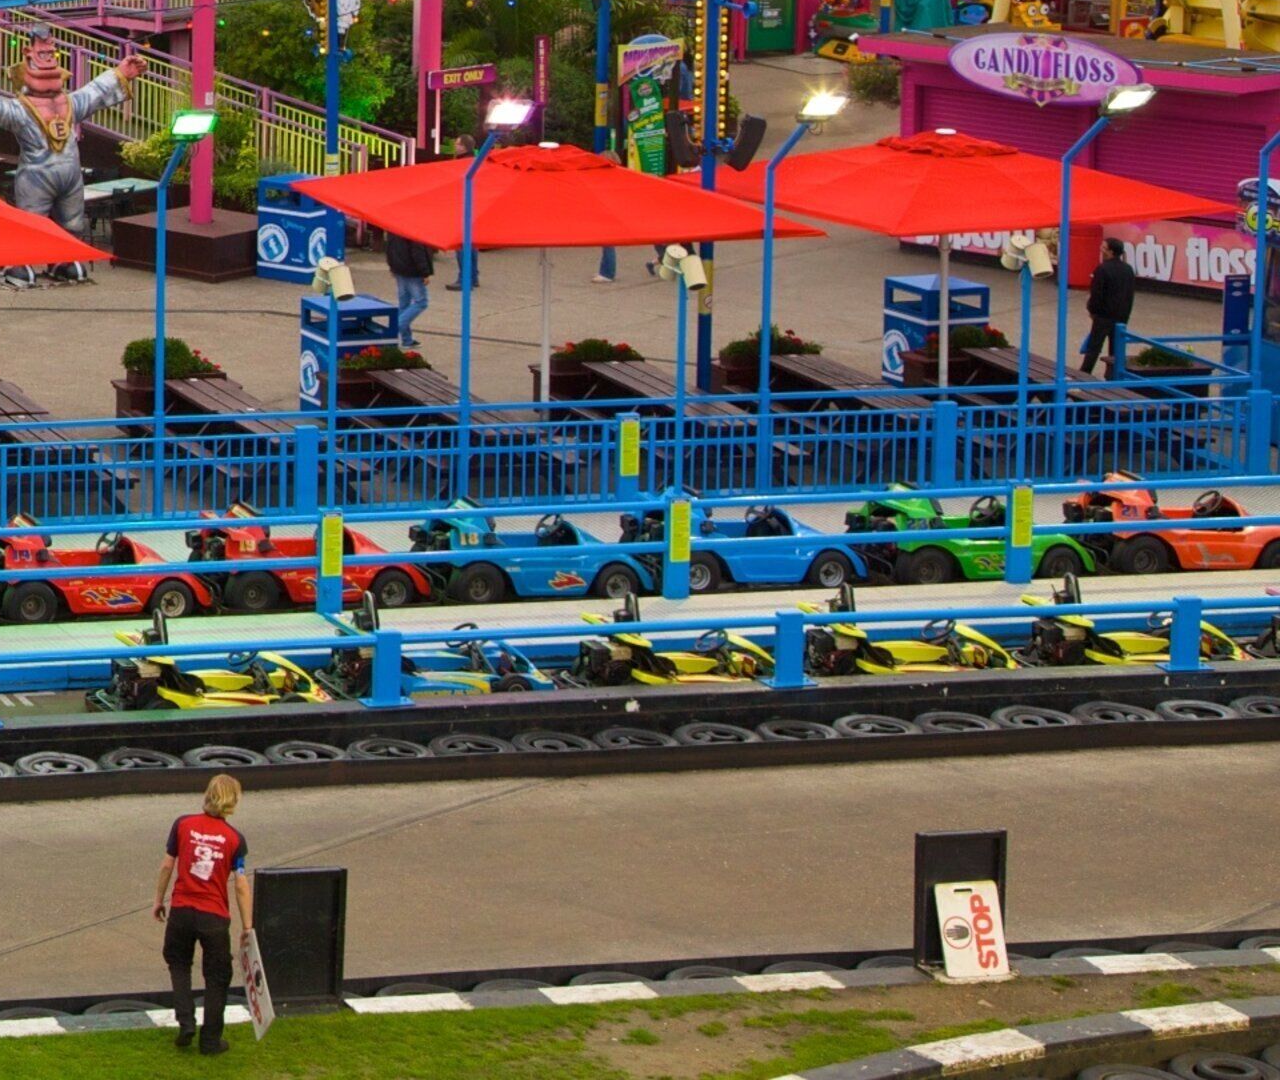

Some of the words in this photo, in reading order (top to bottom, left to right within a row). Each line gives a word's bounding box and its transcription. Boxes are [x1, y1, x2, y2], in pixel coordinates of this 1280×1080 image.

[974, 48, 1041, 78] CANDY
[1052, 49, 1116, 83] FLOSS
[443, 72, 462, 85] EXIT
[463, 70, 486, 82] ONLY
[56, 123, 66, 137] E
[239, 539, 256, 553] 19
[459, 531, 480, 547] 18
[969, 893, 1000, 970] STOP
